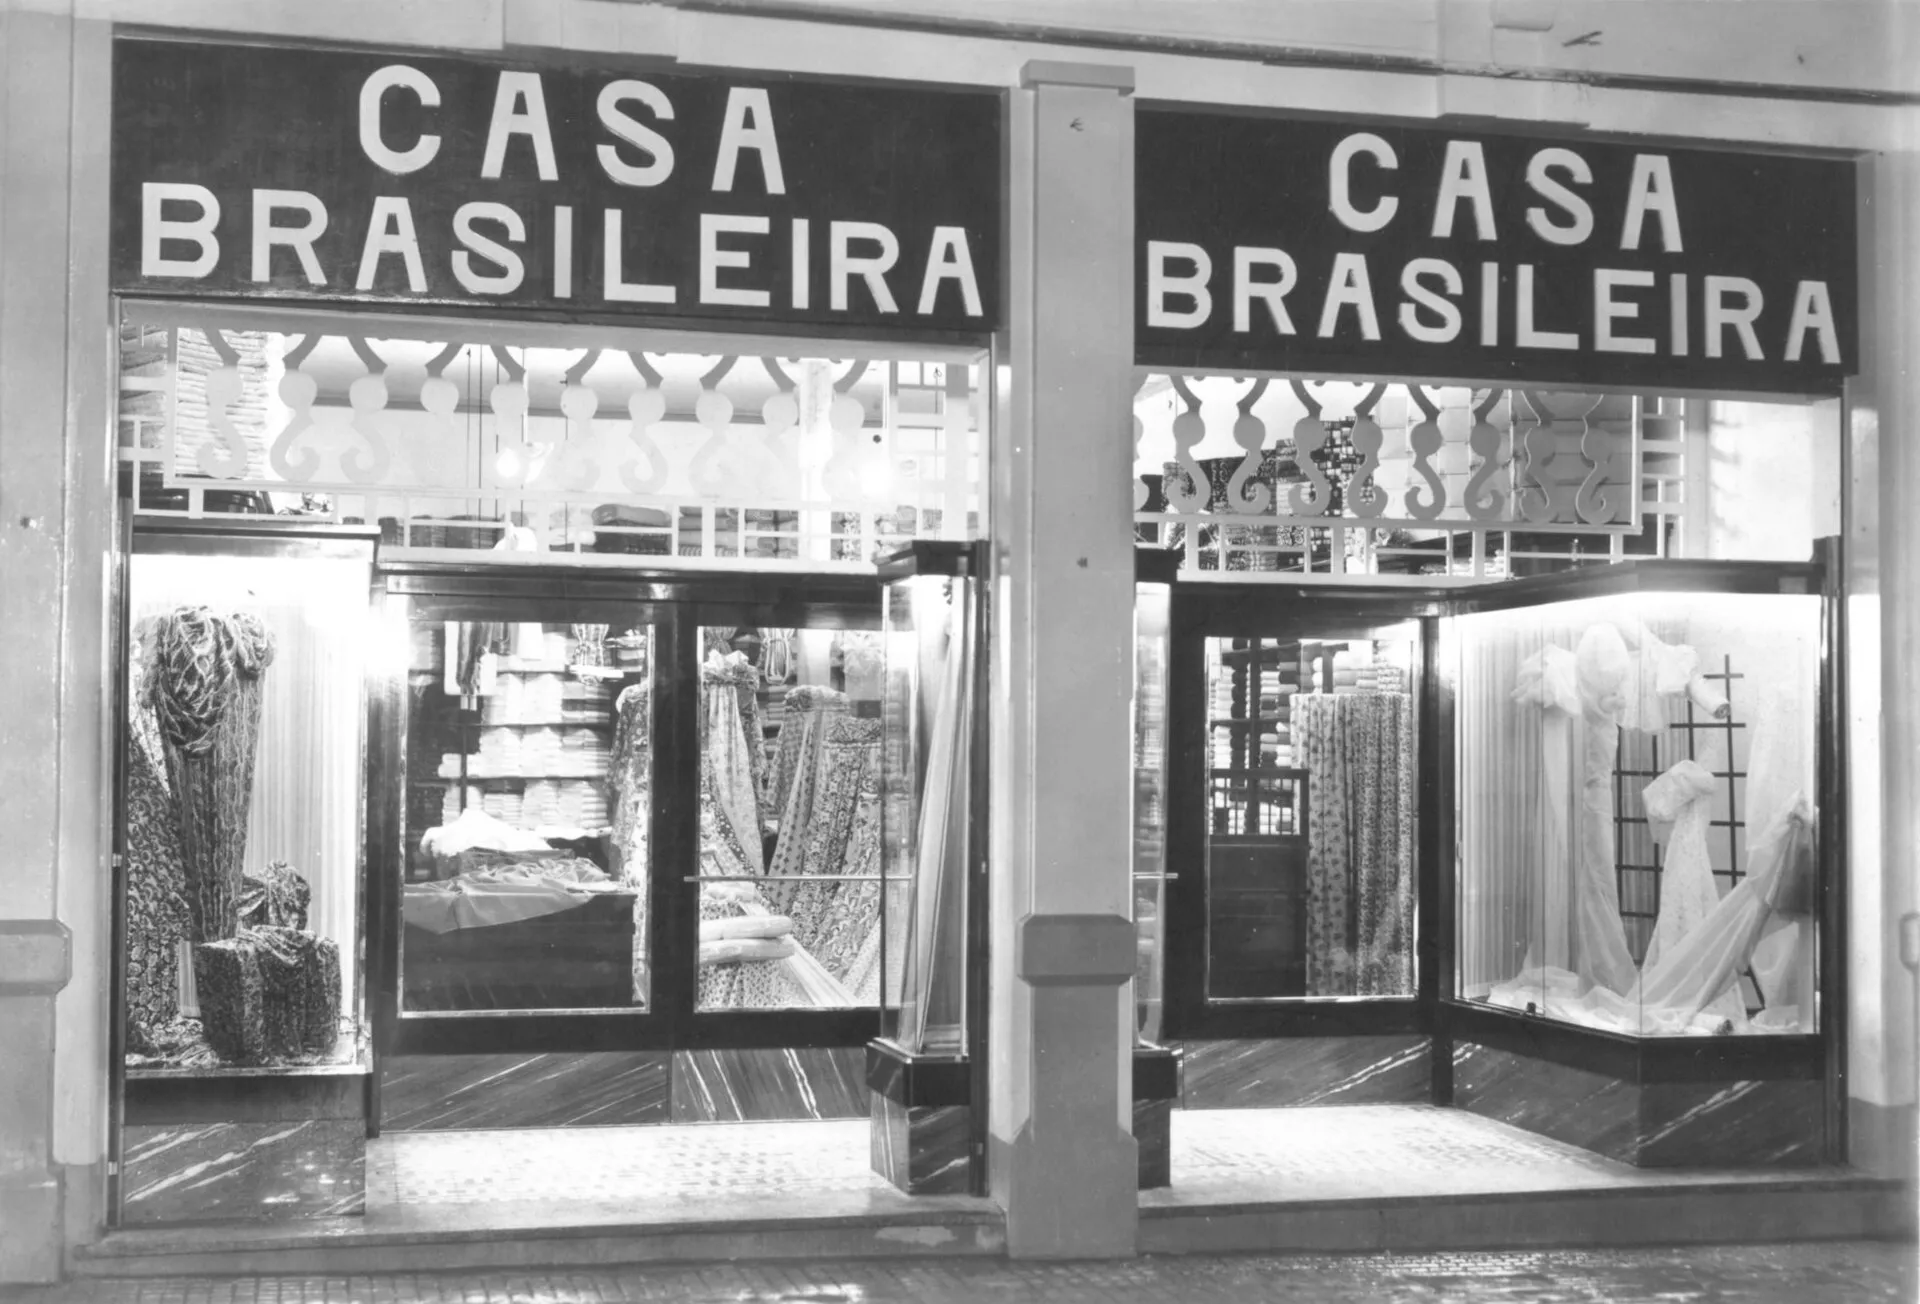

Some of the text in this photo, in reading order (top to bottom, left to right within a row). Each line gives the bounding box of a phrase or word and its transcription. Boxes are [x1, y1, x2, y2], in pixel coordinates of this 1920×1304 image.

[359, 64, 786, 195] CASA
[1328, 132, 1683, 253] CASA
[140, 181, 984, 318] BRASILEIRA
[1146, 240, 1842, 364] BRASILEIRA
